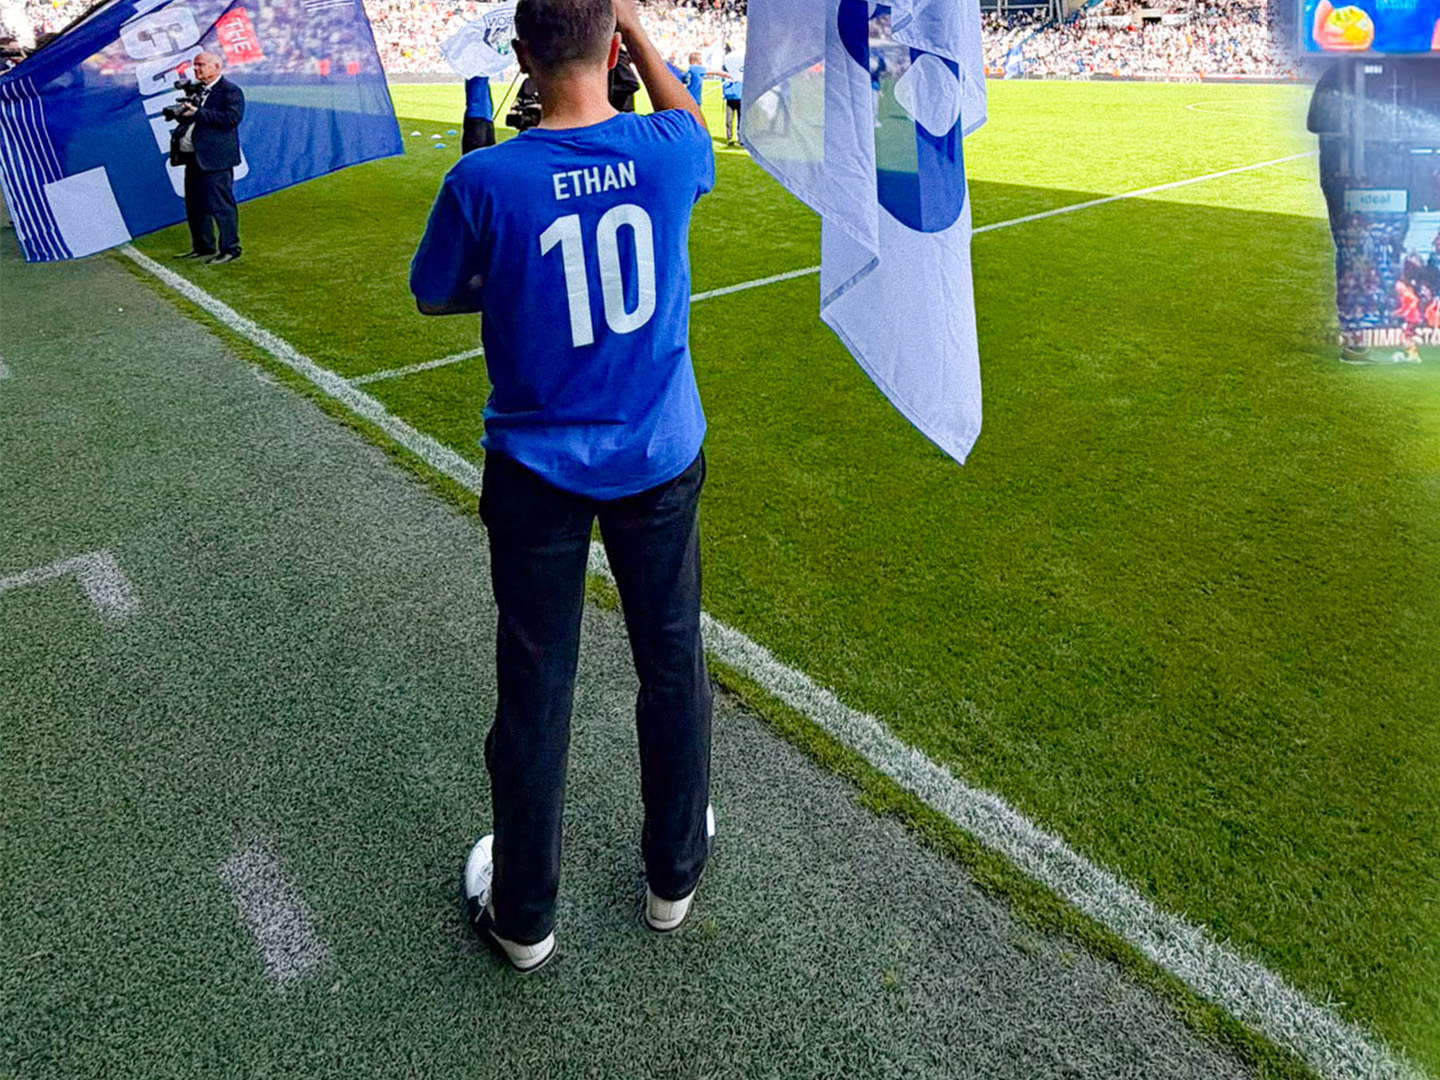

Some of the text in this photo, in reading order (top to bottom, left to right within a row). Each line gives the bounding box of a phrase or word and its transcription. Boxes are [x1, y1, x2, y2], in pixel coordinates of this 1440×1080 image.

[225, 18, 253, 55] THE
[552, 160, 637, 201] ETHAN
[539, 203, 656, 348] 10
